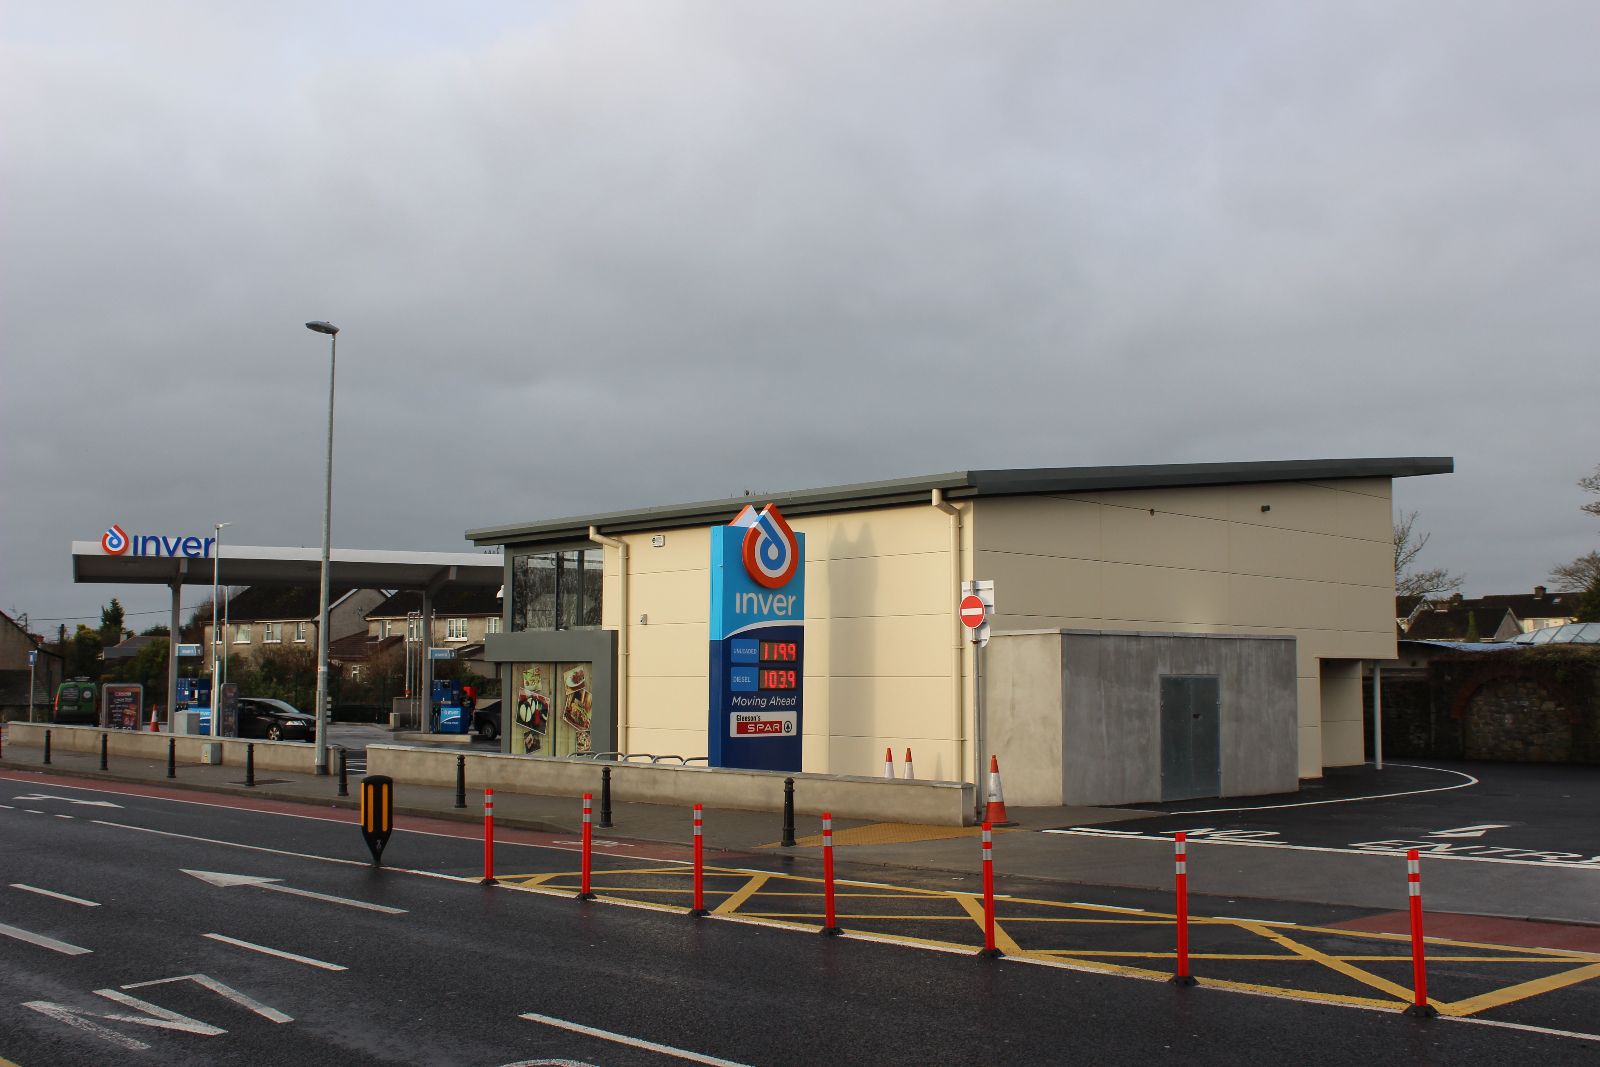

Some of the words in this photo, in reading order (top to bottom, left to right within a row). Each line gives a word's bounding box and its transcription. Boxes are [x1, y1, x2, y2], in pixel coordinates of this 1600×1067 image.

[133, 535, 216, 558] inver
[735, 592, 797, 617] inver
[731, 695, 767, 707] Moving
[768, 695, 797, 706] Ahead
[736, 714, 761, 722] Gleeson's
[747, 723, 780, 733] SPAR
